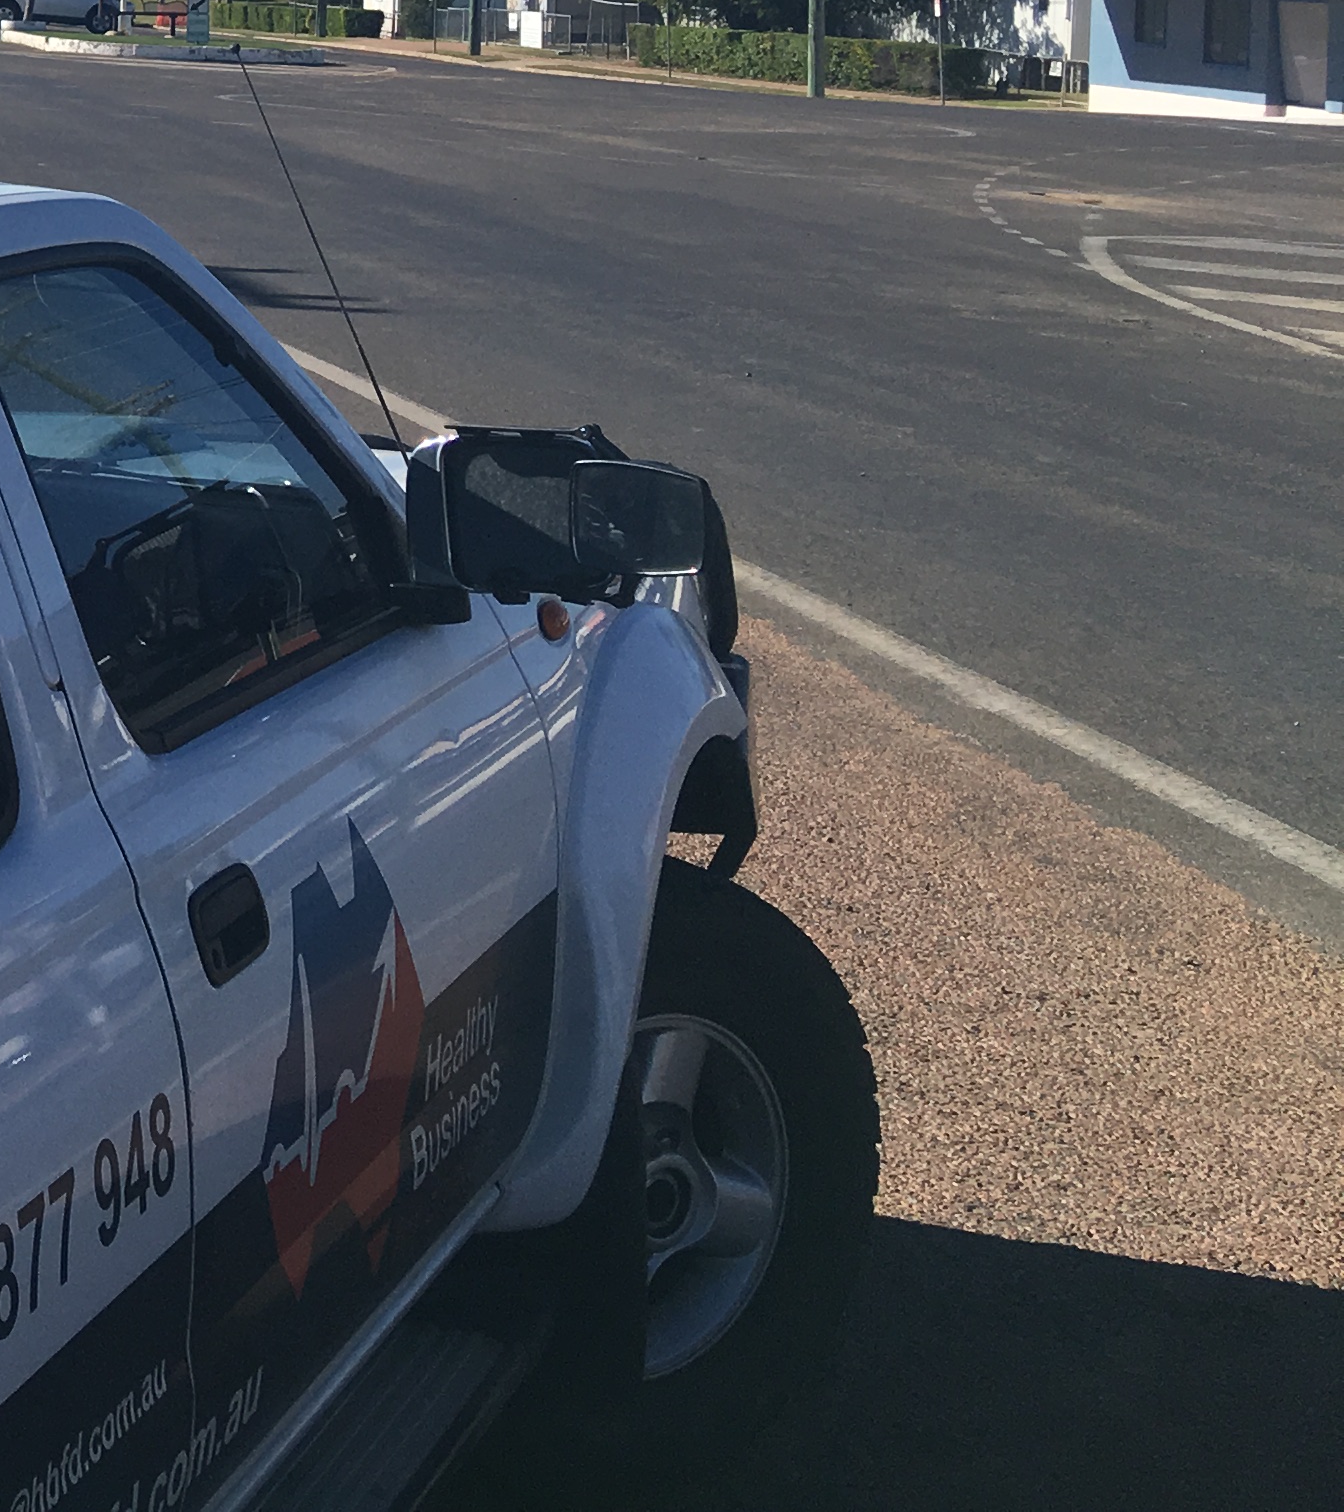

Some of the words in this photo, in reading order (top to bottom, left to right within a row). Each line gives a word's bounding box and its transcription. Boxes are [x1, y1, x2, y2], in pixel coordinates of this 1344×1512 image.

[425, 994, 498, 1102] Healthy
[94, 1092, 176, 1247] 948
[411, 1061, 501, 1190] Business
